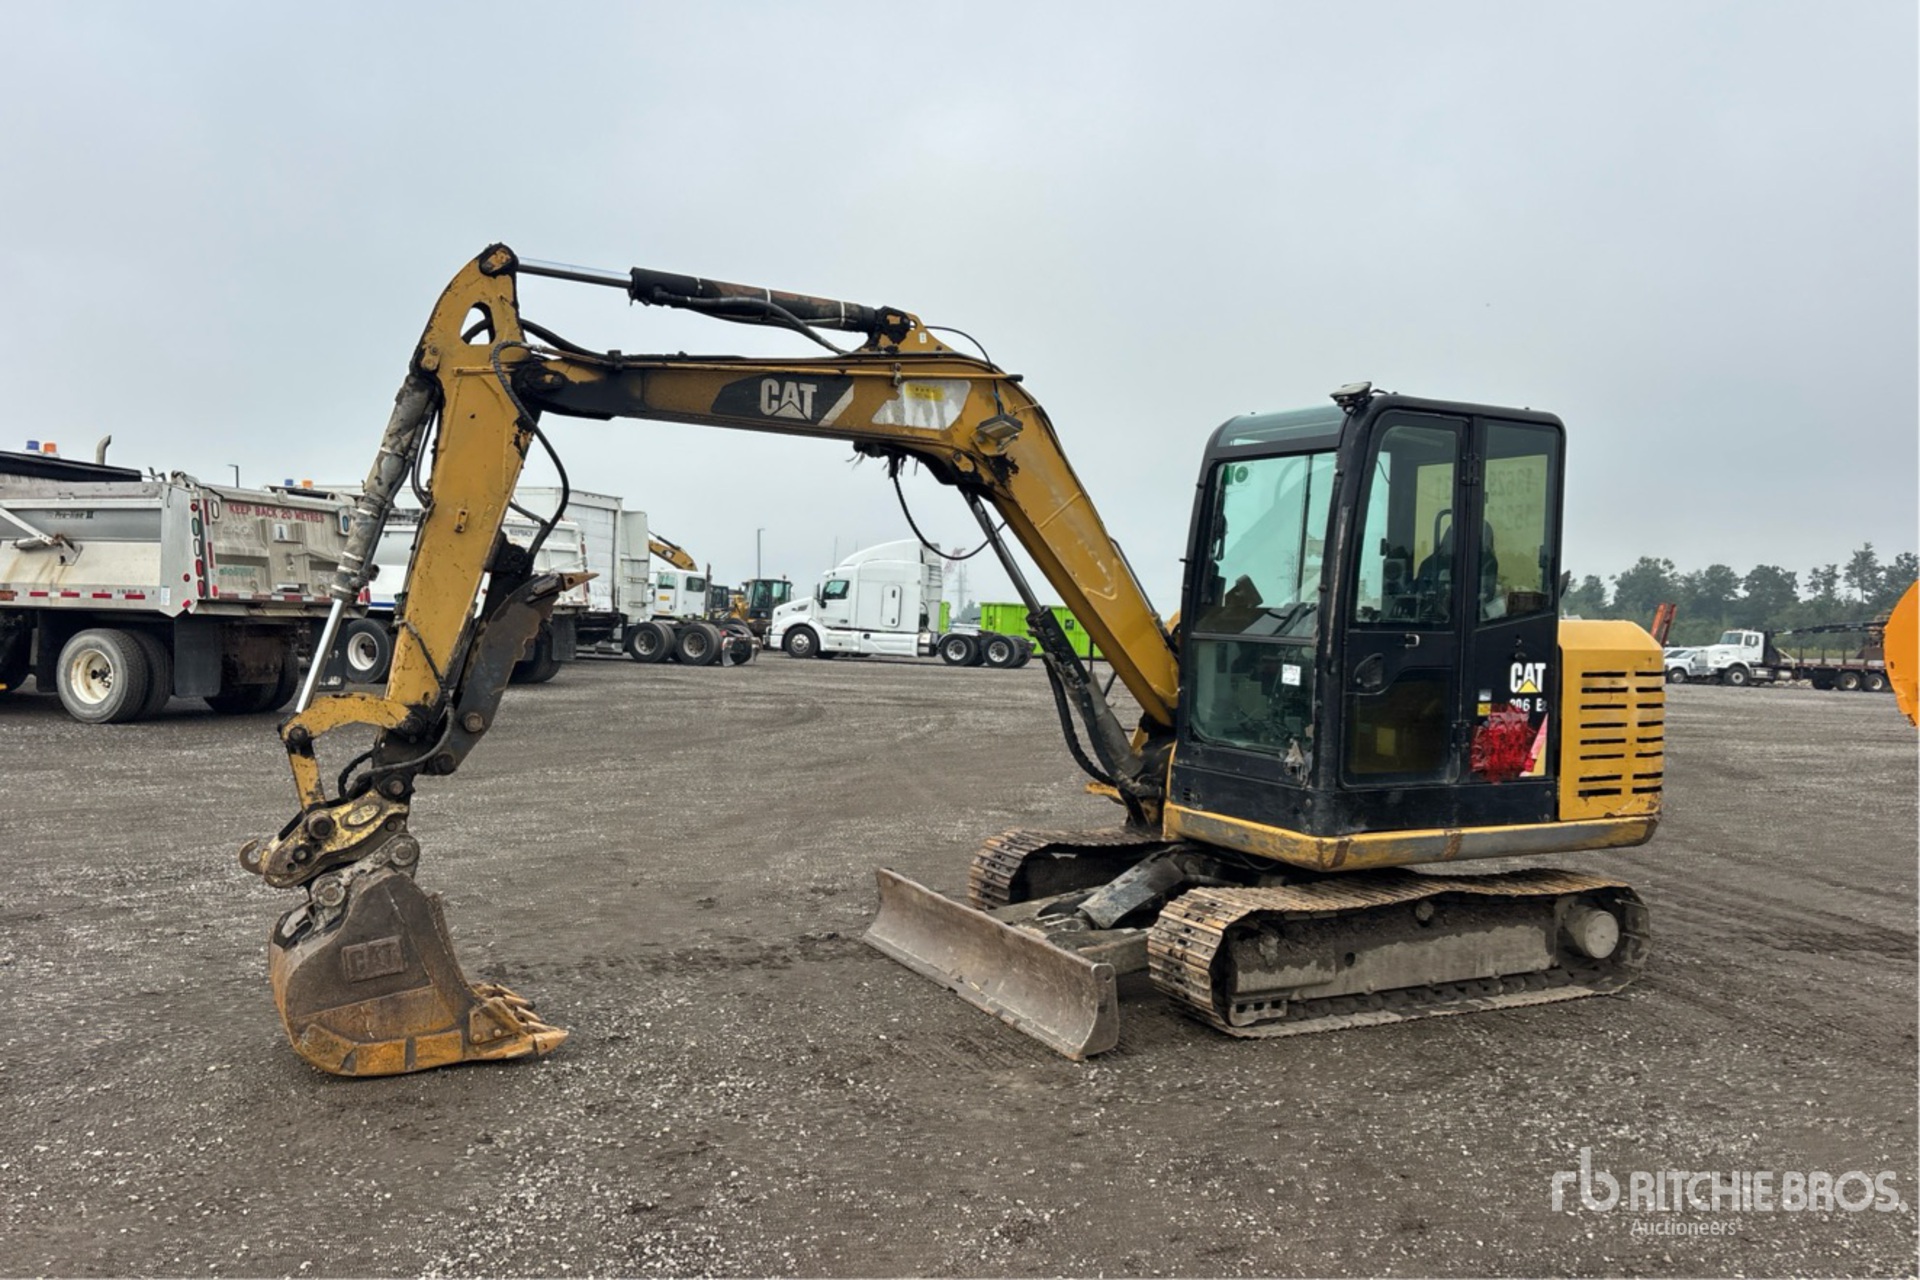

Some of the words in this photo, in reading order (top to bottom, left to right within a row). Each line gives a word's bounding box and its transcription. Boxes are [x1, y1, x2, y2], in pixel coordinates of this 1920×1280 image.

[760, 378, 817, 421] CAT
[229, 503, 251, 515] KEEP
[255, 505, 277, 518] BACK
[281, 508, 292, 519] 20
[295, 510, 325, 523] METRES
[1510, 662, 1546, 693] CAT
